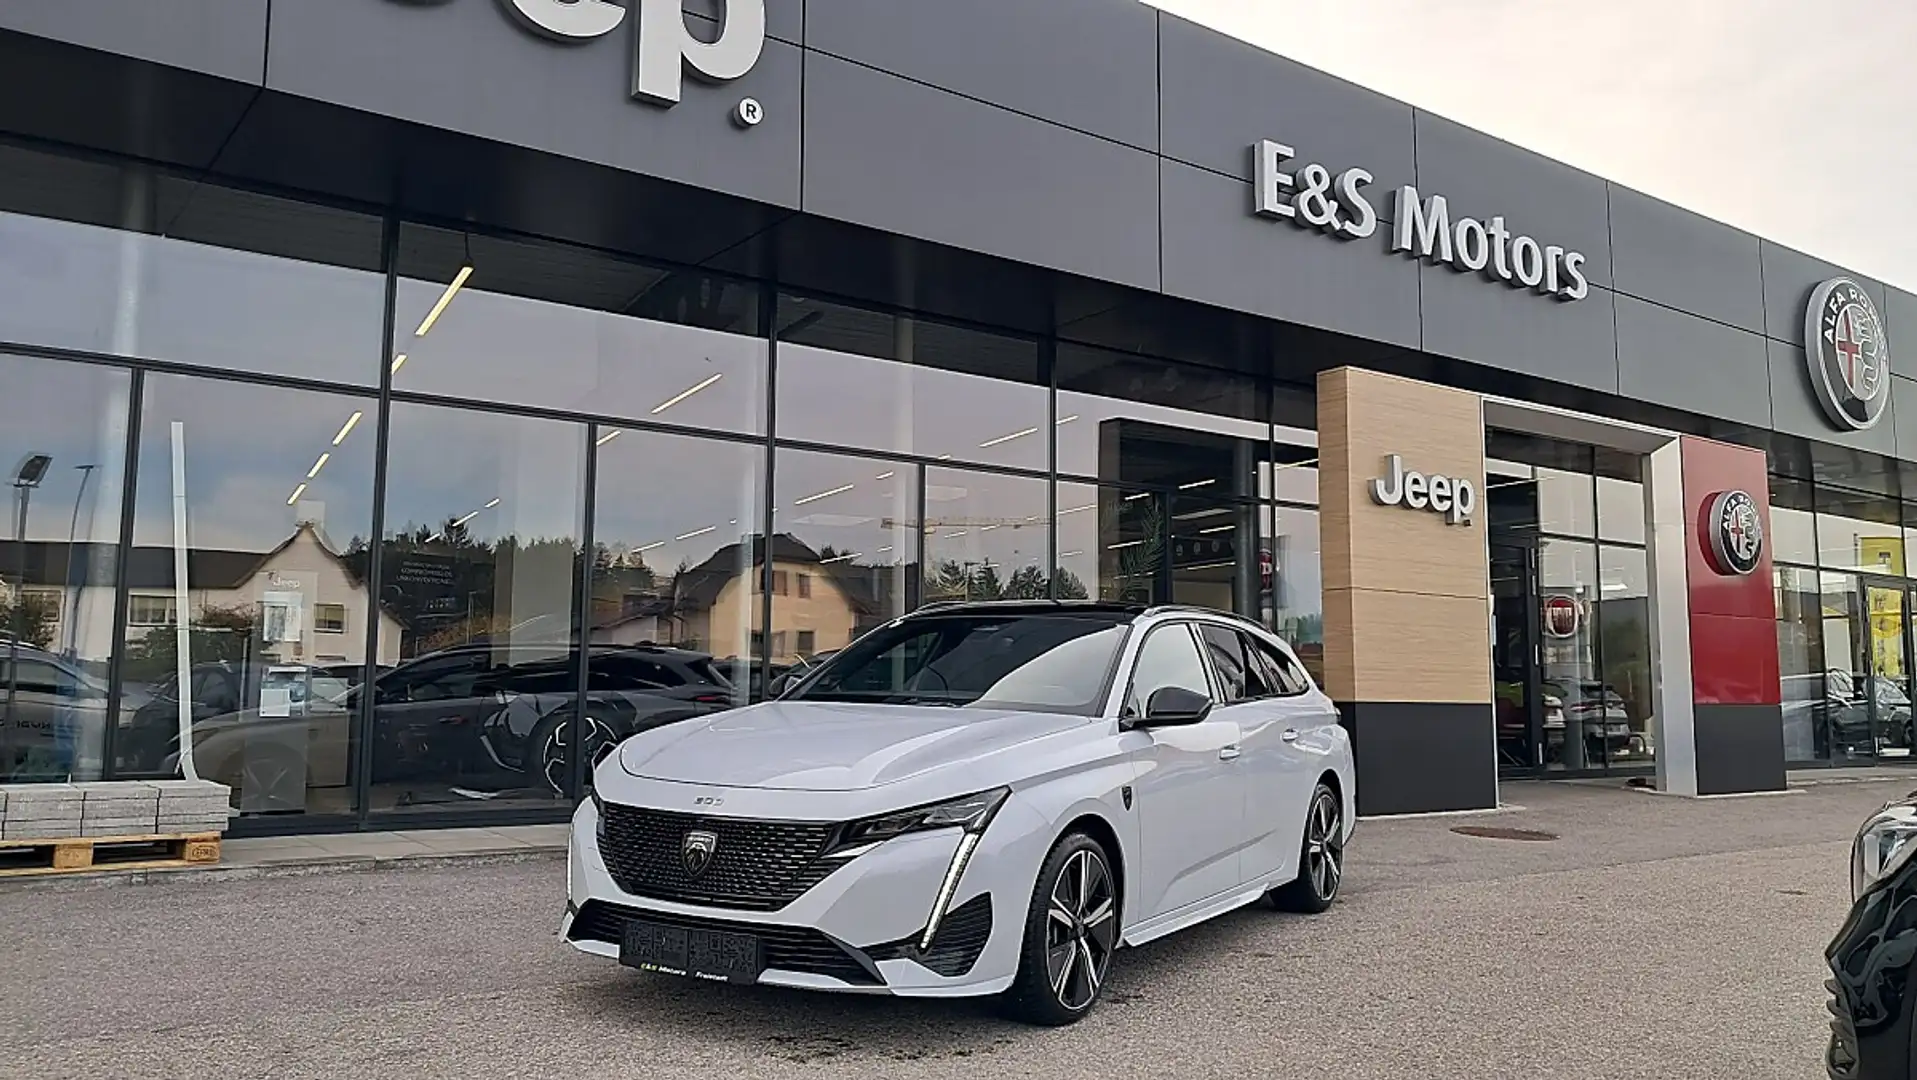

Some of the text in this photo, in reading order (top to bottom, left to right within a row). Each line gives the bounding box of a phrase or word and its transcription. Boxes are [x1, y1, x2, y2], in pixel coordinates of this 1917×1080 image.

[1254, 139, 1588, 300] E&S Motors
[1823, 291, 1847, 344] ALFA
[1372, 454, 1474, 524] Jeep
